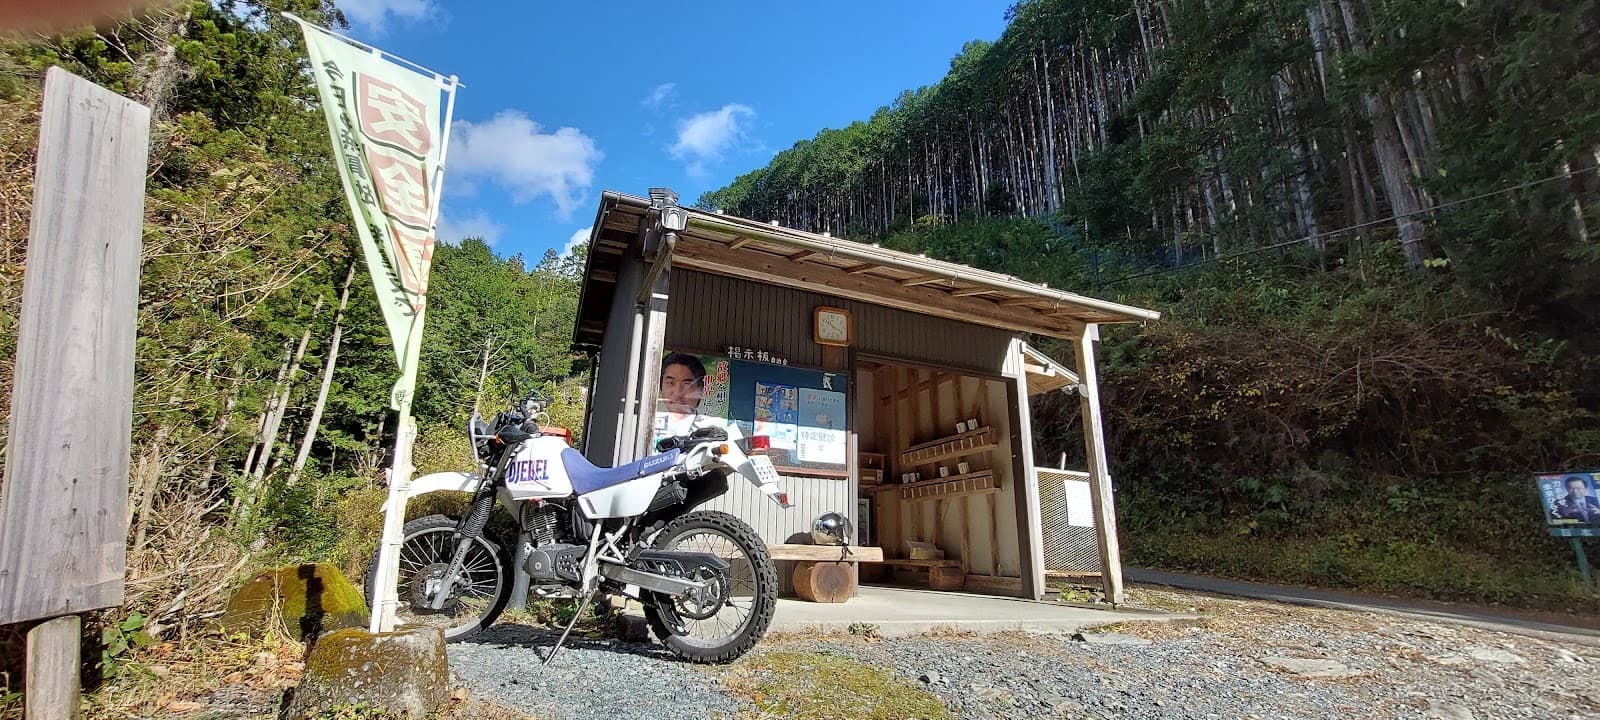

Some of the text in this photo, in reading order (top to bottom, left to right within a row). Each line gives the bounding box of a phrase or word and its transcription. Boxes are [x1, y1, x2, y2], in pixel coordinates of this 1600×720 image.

[727, 345, 789, 366] 掲示板 自治会
[643, 452, 674, 469] SUZUKI
[507, 459, 549, 484] DJEBEL
